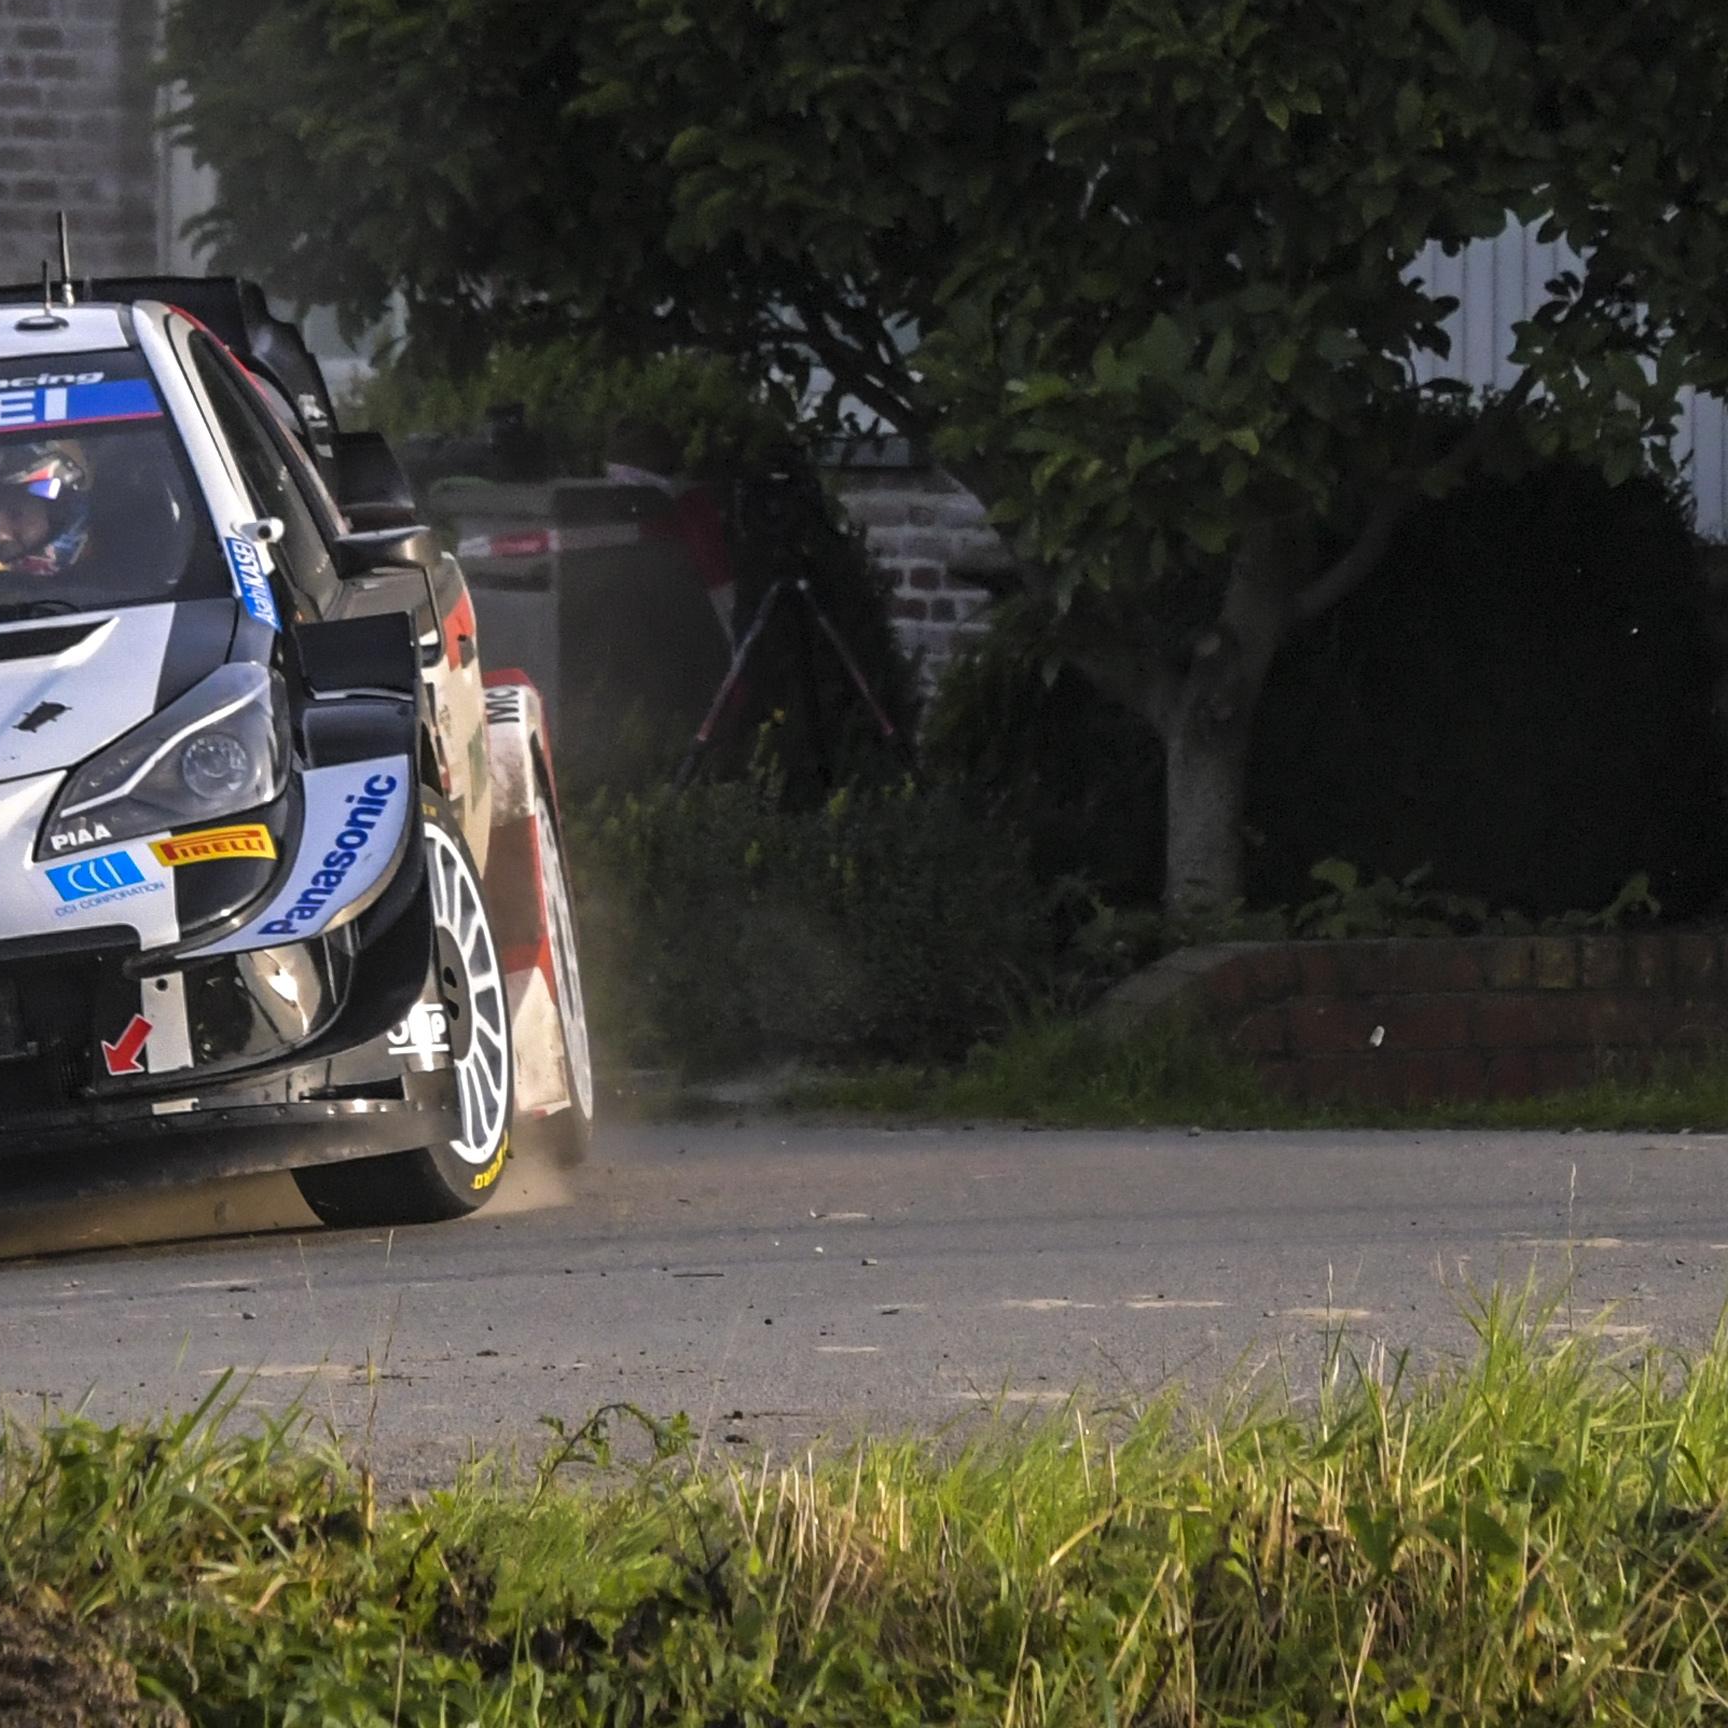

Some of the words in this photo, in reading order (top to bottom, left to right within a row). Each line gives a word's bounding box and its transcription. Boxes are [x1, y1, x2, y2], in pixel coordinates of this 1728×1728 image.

[50, 823, 112, 851] PIAA
[160, 830, 267, 861] PIRELLI
[257, 774, 397, 935] Panasonic
